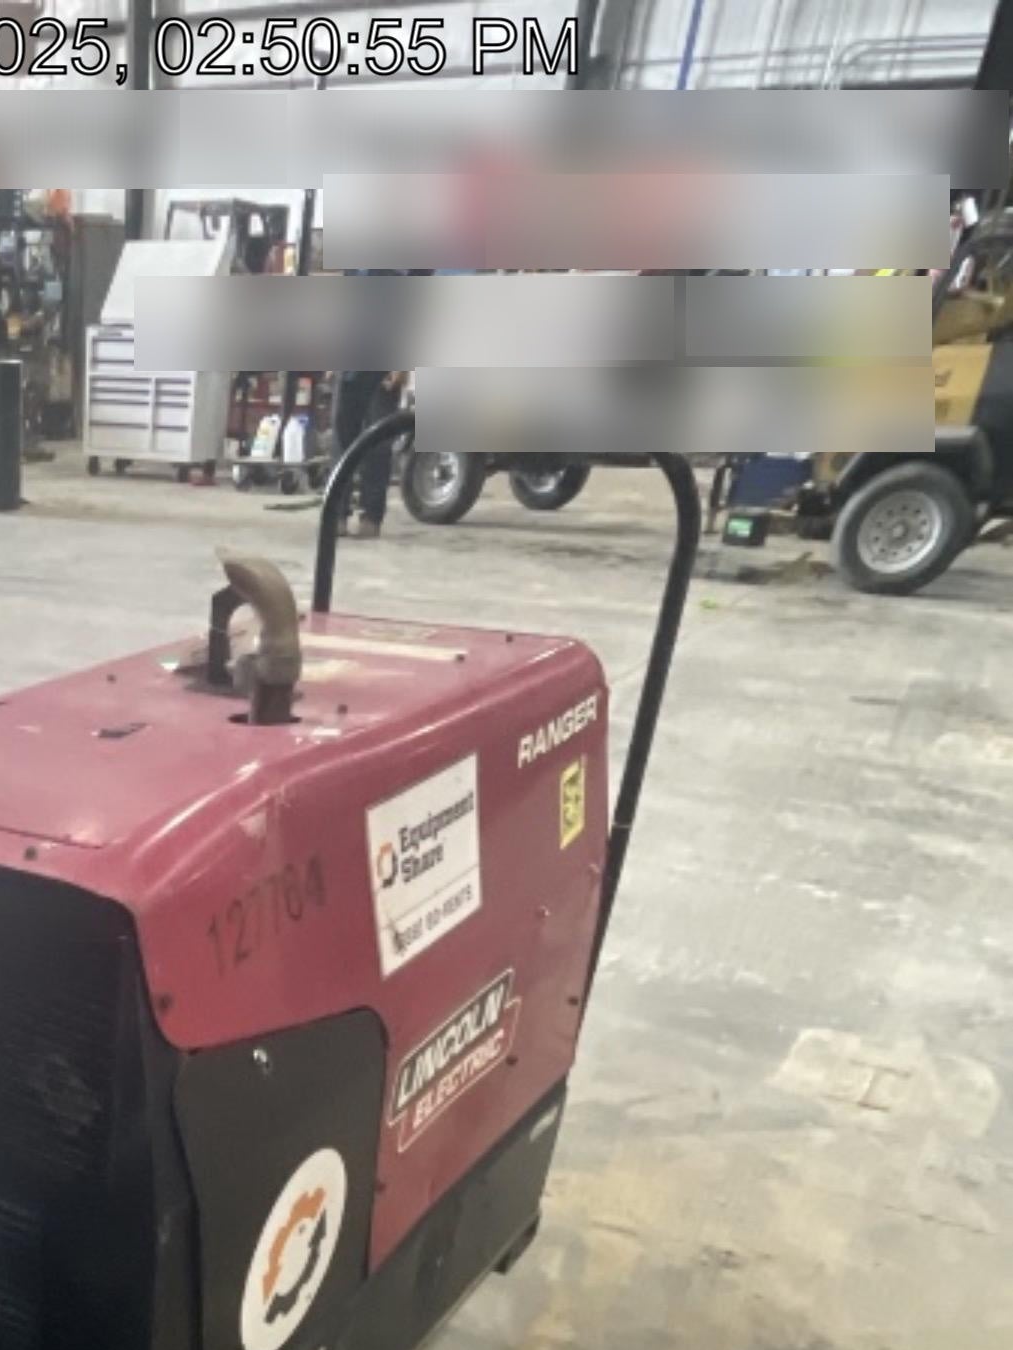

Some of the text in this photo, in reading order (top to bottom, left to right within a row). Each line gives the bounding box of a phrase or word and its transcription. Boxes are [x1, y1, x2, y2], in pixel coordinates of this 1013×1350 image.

[517, 693, 598, 769] RANGER
[396, 982, 504, 1109] LINCOLN
[412, 1028, 505, 1130] ELECTRIC
